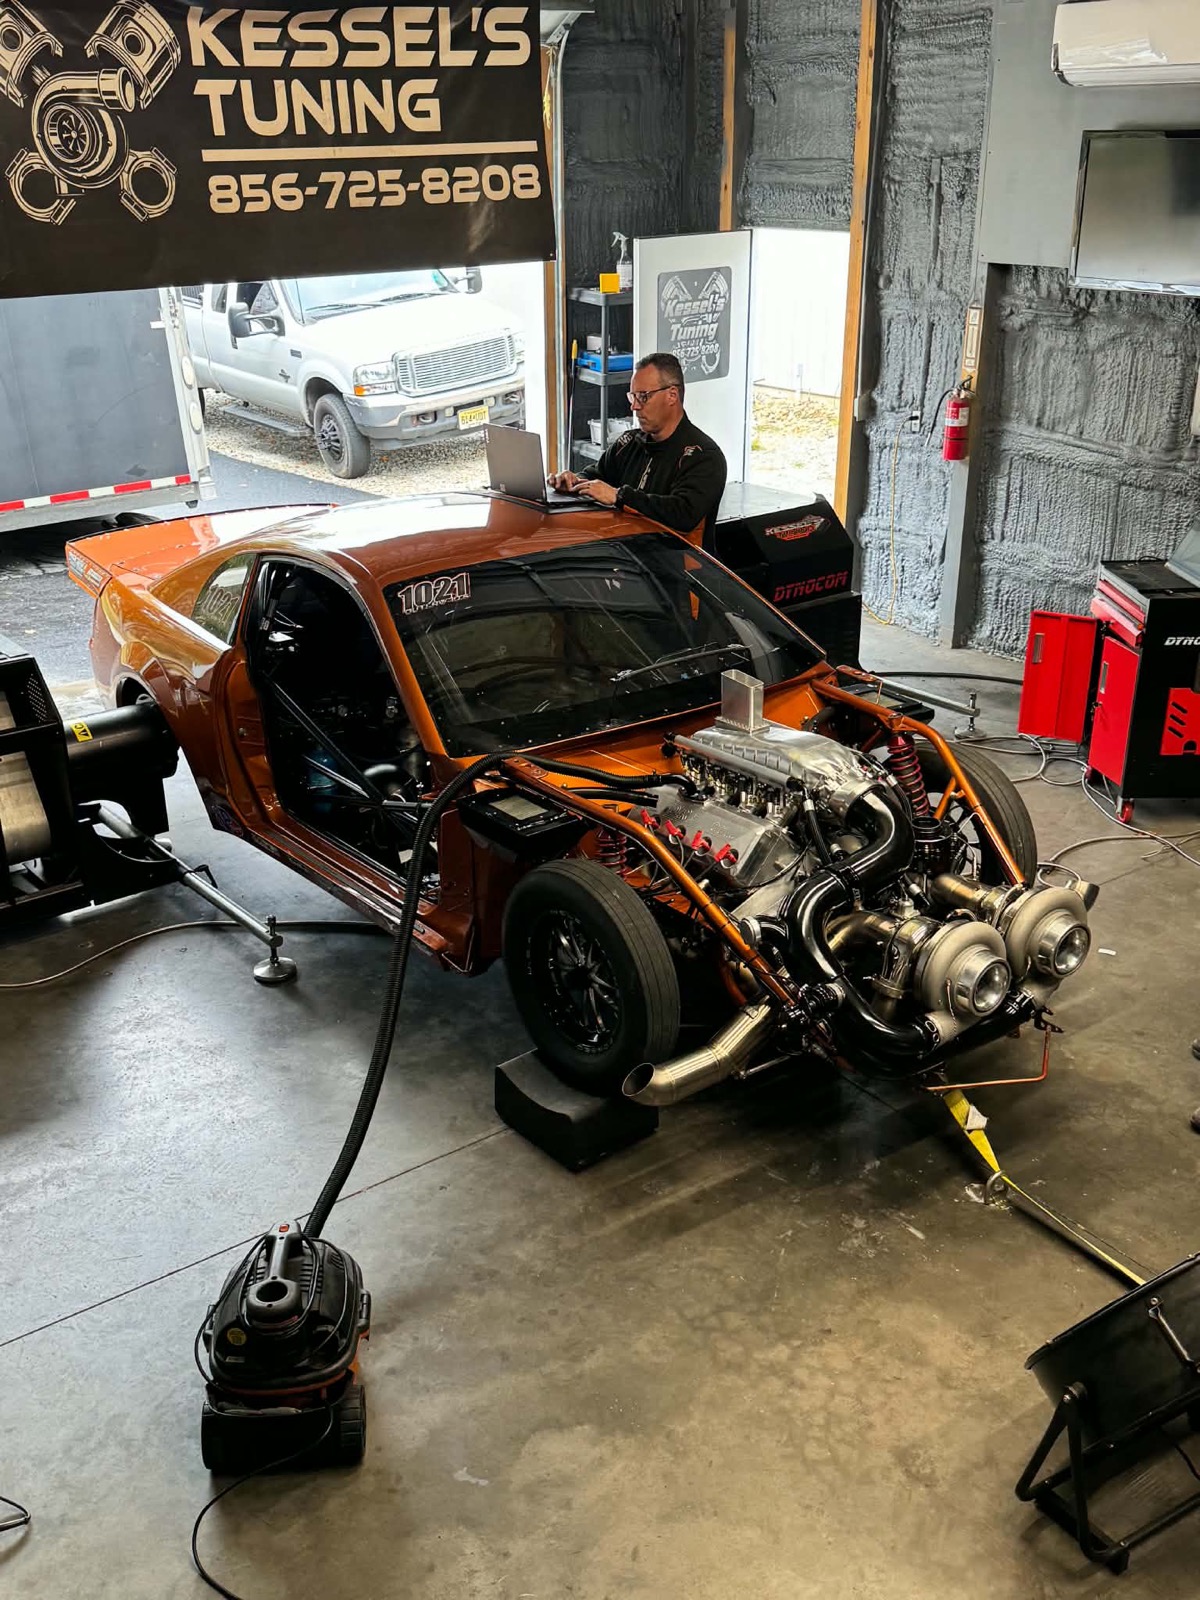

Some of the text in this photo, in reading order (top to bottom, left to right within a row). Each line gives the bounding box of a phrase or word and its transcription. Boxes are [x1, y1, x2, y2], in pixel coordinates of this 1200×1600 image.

[186, 5, 532, 69] KESSEL'S
[193, 78, 443, 138] TUNING
[207, 163, 542, 215] 856-725-8208
[663, 293, 727, 319] Kessel's
[670, 321, 719, 342] Tuning
[202, 584, 240, 626] 1021
[397, 572, 471, 613] 1021
[773, 570, 849, 603] DYNOCOM
